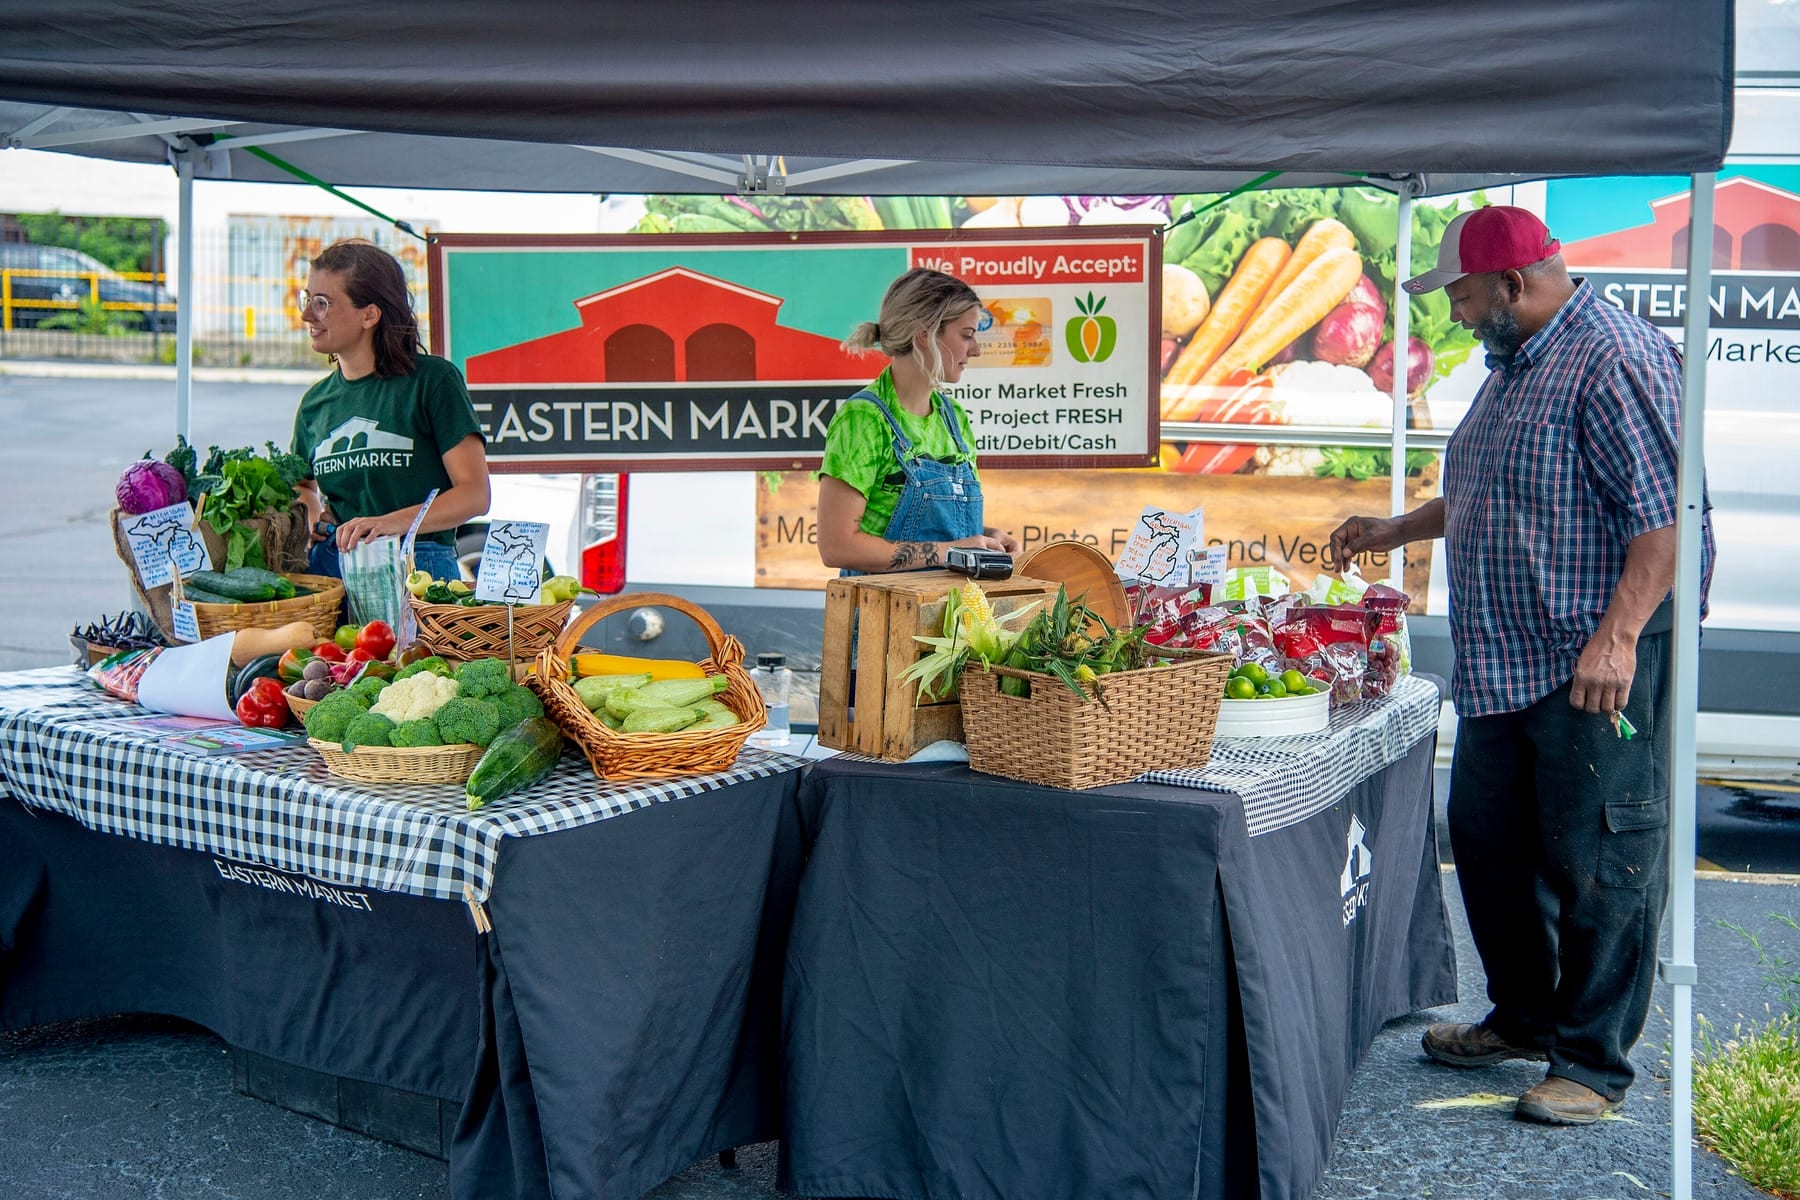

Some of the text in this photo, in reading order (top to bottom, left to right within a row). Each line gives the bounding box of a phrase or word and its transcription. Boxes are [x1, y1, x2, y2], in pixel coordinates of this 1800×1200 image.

[918, 255, 1137, 279] We Proudly Accept:
[998, 384, 1067, 399] Market
[1073, 383, 1127, 398] Fresh
[474, 399, 848, 443] EASTERN MARK
[980, 409, 1049, 428] Project
[1056, 408, 1122, 424] FRESH
[349, 452, 413, 469] MARKET
[213, 859, 373, 911] EASTERN MARKET
